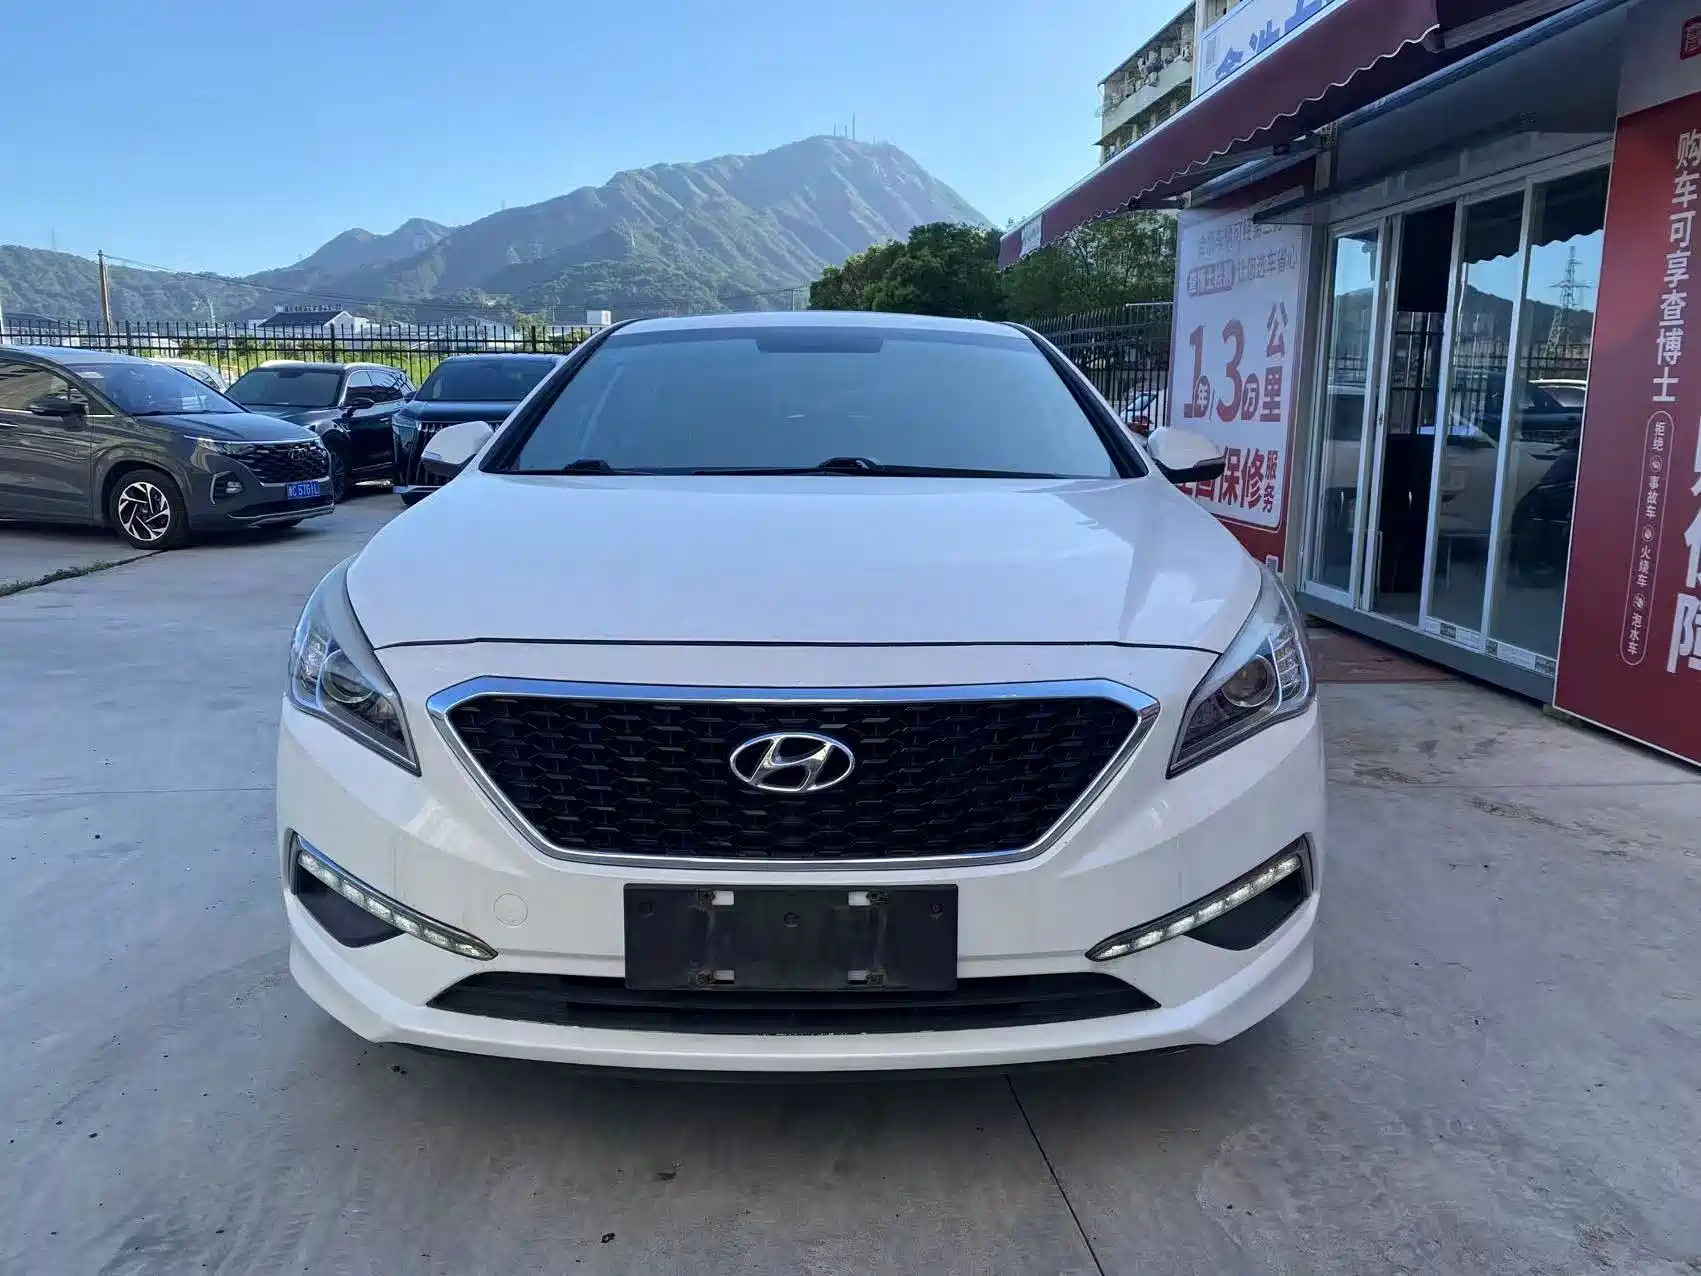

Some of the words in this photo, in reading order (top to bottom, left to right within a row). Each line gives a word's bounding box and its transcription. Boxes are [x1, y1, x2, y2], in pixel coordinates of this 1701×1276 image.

[1651, 128, 1701, 402] 购车可享查博士
[1636, 544, 1651, 588] 火烧车
[1628, 612, 1643, 655] 泡水车
